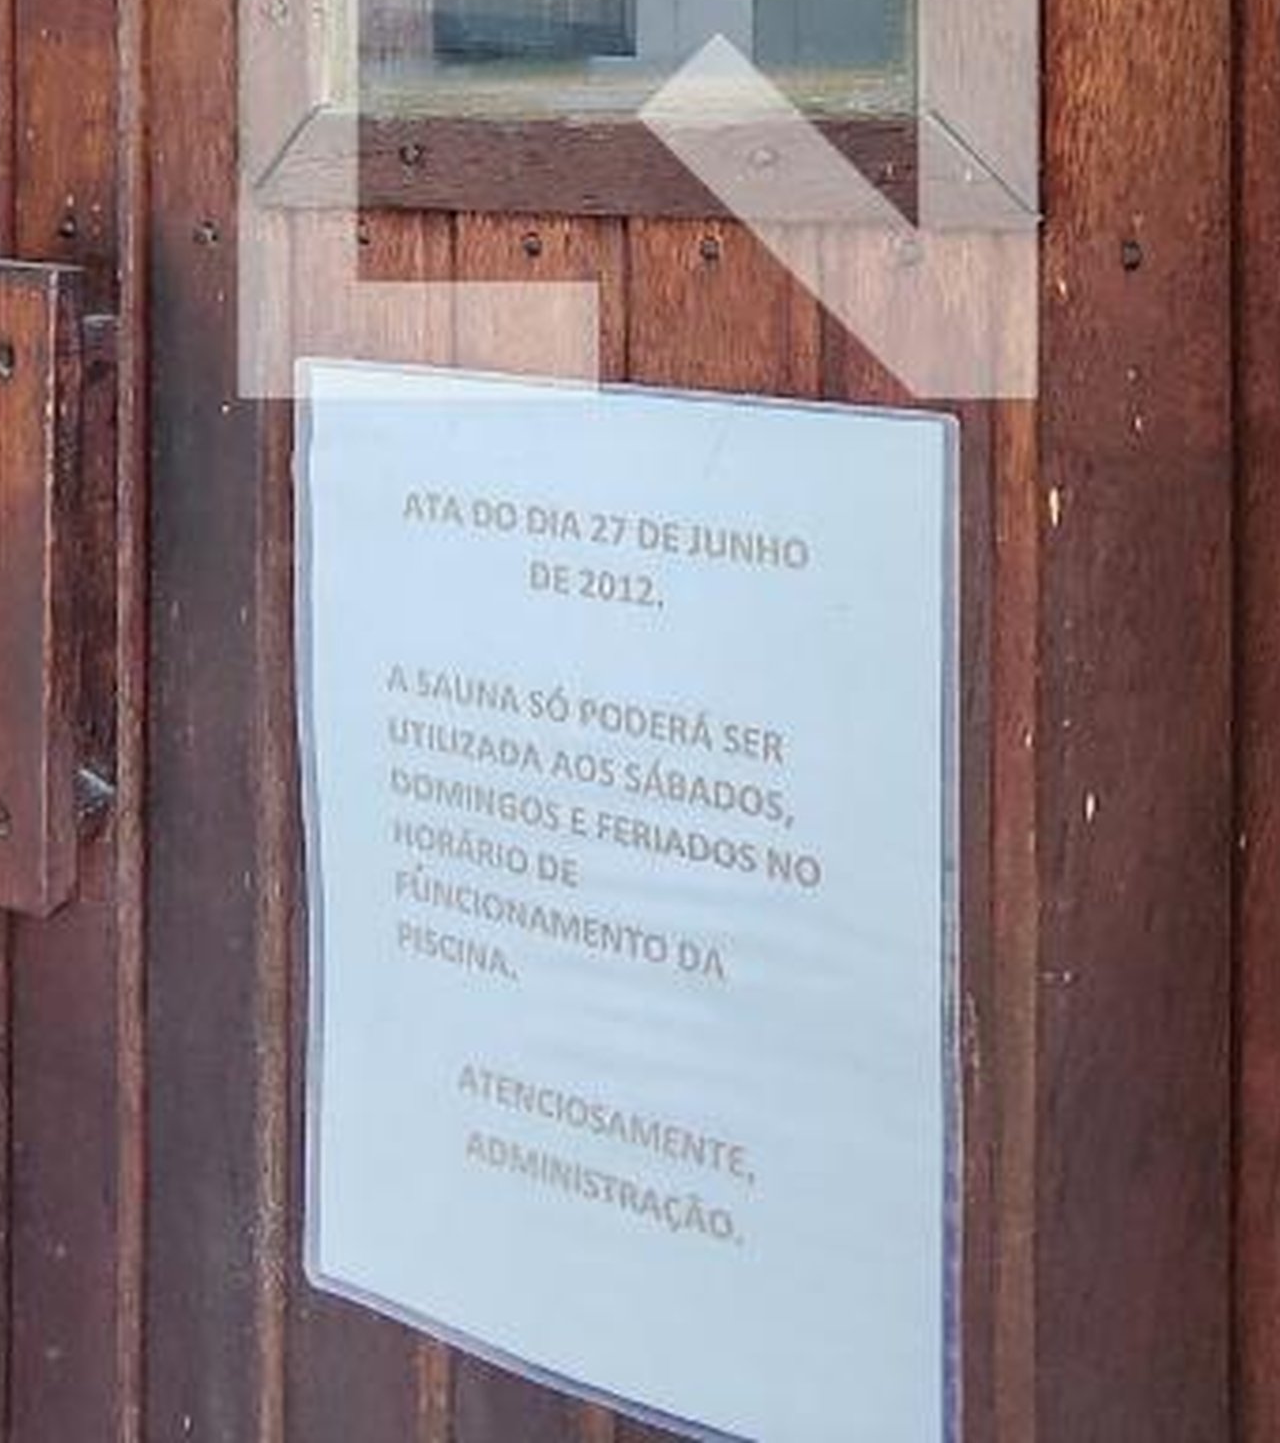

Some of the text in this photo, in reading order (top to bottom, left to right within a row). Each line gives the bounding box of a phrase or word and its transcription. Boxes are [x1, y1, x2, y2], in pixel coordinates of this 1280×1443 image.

[403, 492, 809, 569] ATA DO DIA 27 DE JUNHO
[529, 562, 664, 609] DE 2012.
[387, 665, 784, 765] A SAUNA SÓ PODERÁ SER
[389, 718, 796, 830] UTILIZADA AOS SÁBADOS,
[390, 768, 821, 888] DOMINGOS E FERIADOS NO
[393, 819, 579, 888] HORÁRIO DE
[395, 869, 726, 980] FUNCIONAMENTO DA
[397, 919, 520, 980] PISCINA.
[458, 1063, 755, 1185] ATENCIOSAMENTE,
[466, 1130, 744, 1246] ADMINISTRAÇÃO.
